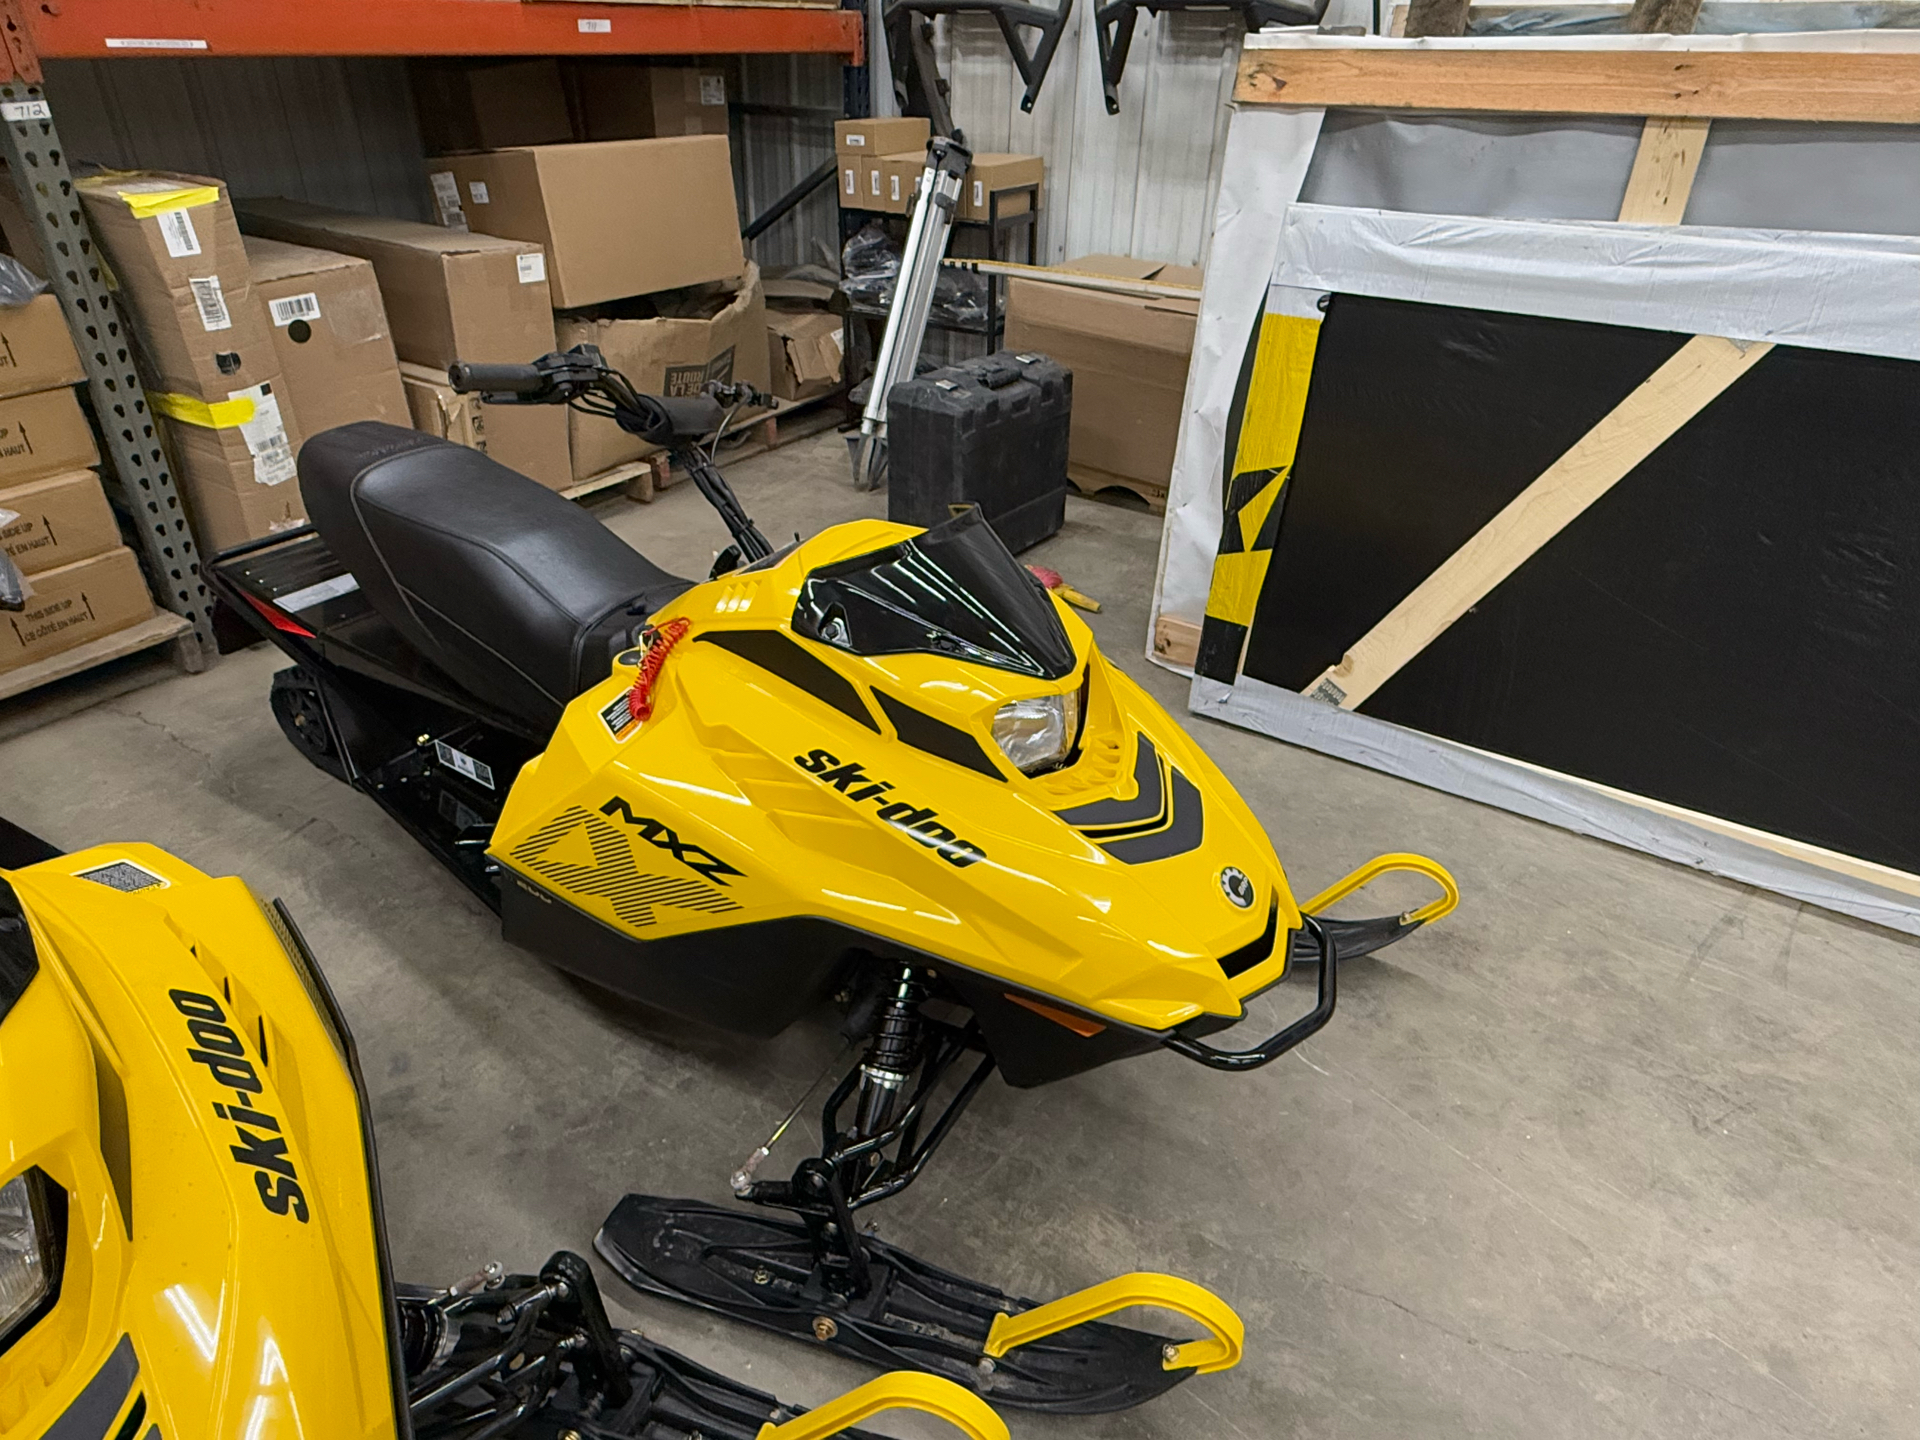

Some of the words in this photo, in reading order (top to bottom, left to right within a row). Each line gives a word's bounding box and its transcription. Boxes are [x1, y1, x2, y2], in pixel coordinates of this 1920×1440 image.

[14, 102, 47, 119] 712
[669, 370, 704, 385] ROUTE
[599, 796, 747, 887] MXZ
[794, 749, 987, 868] ski-doo
[169, 988, 310, 1225] ski-doo
